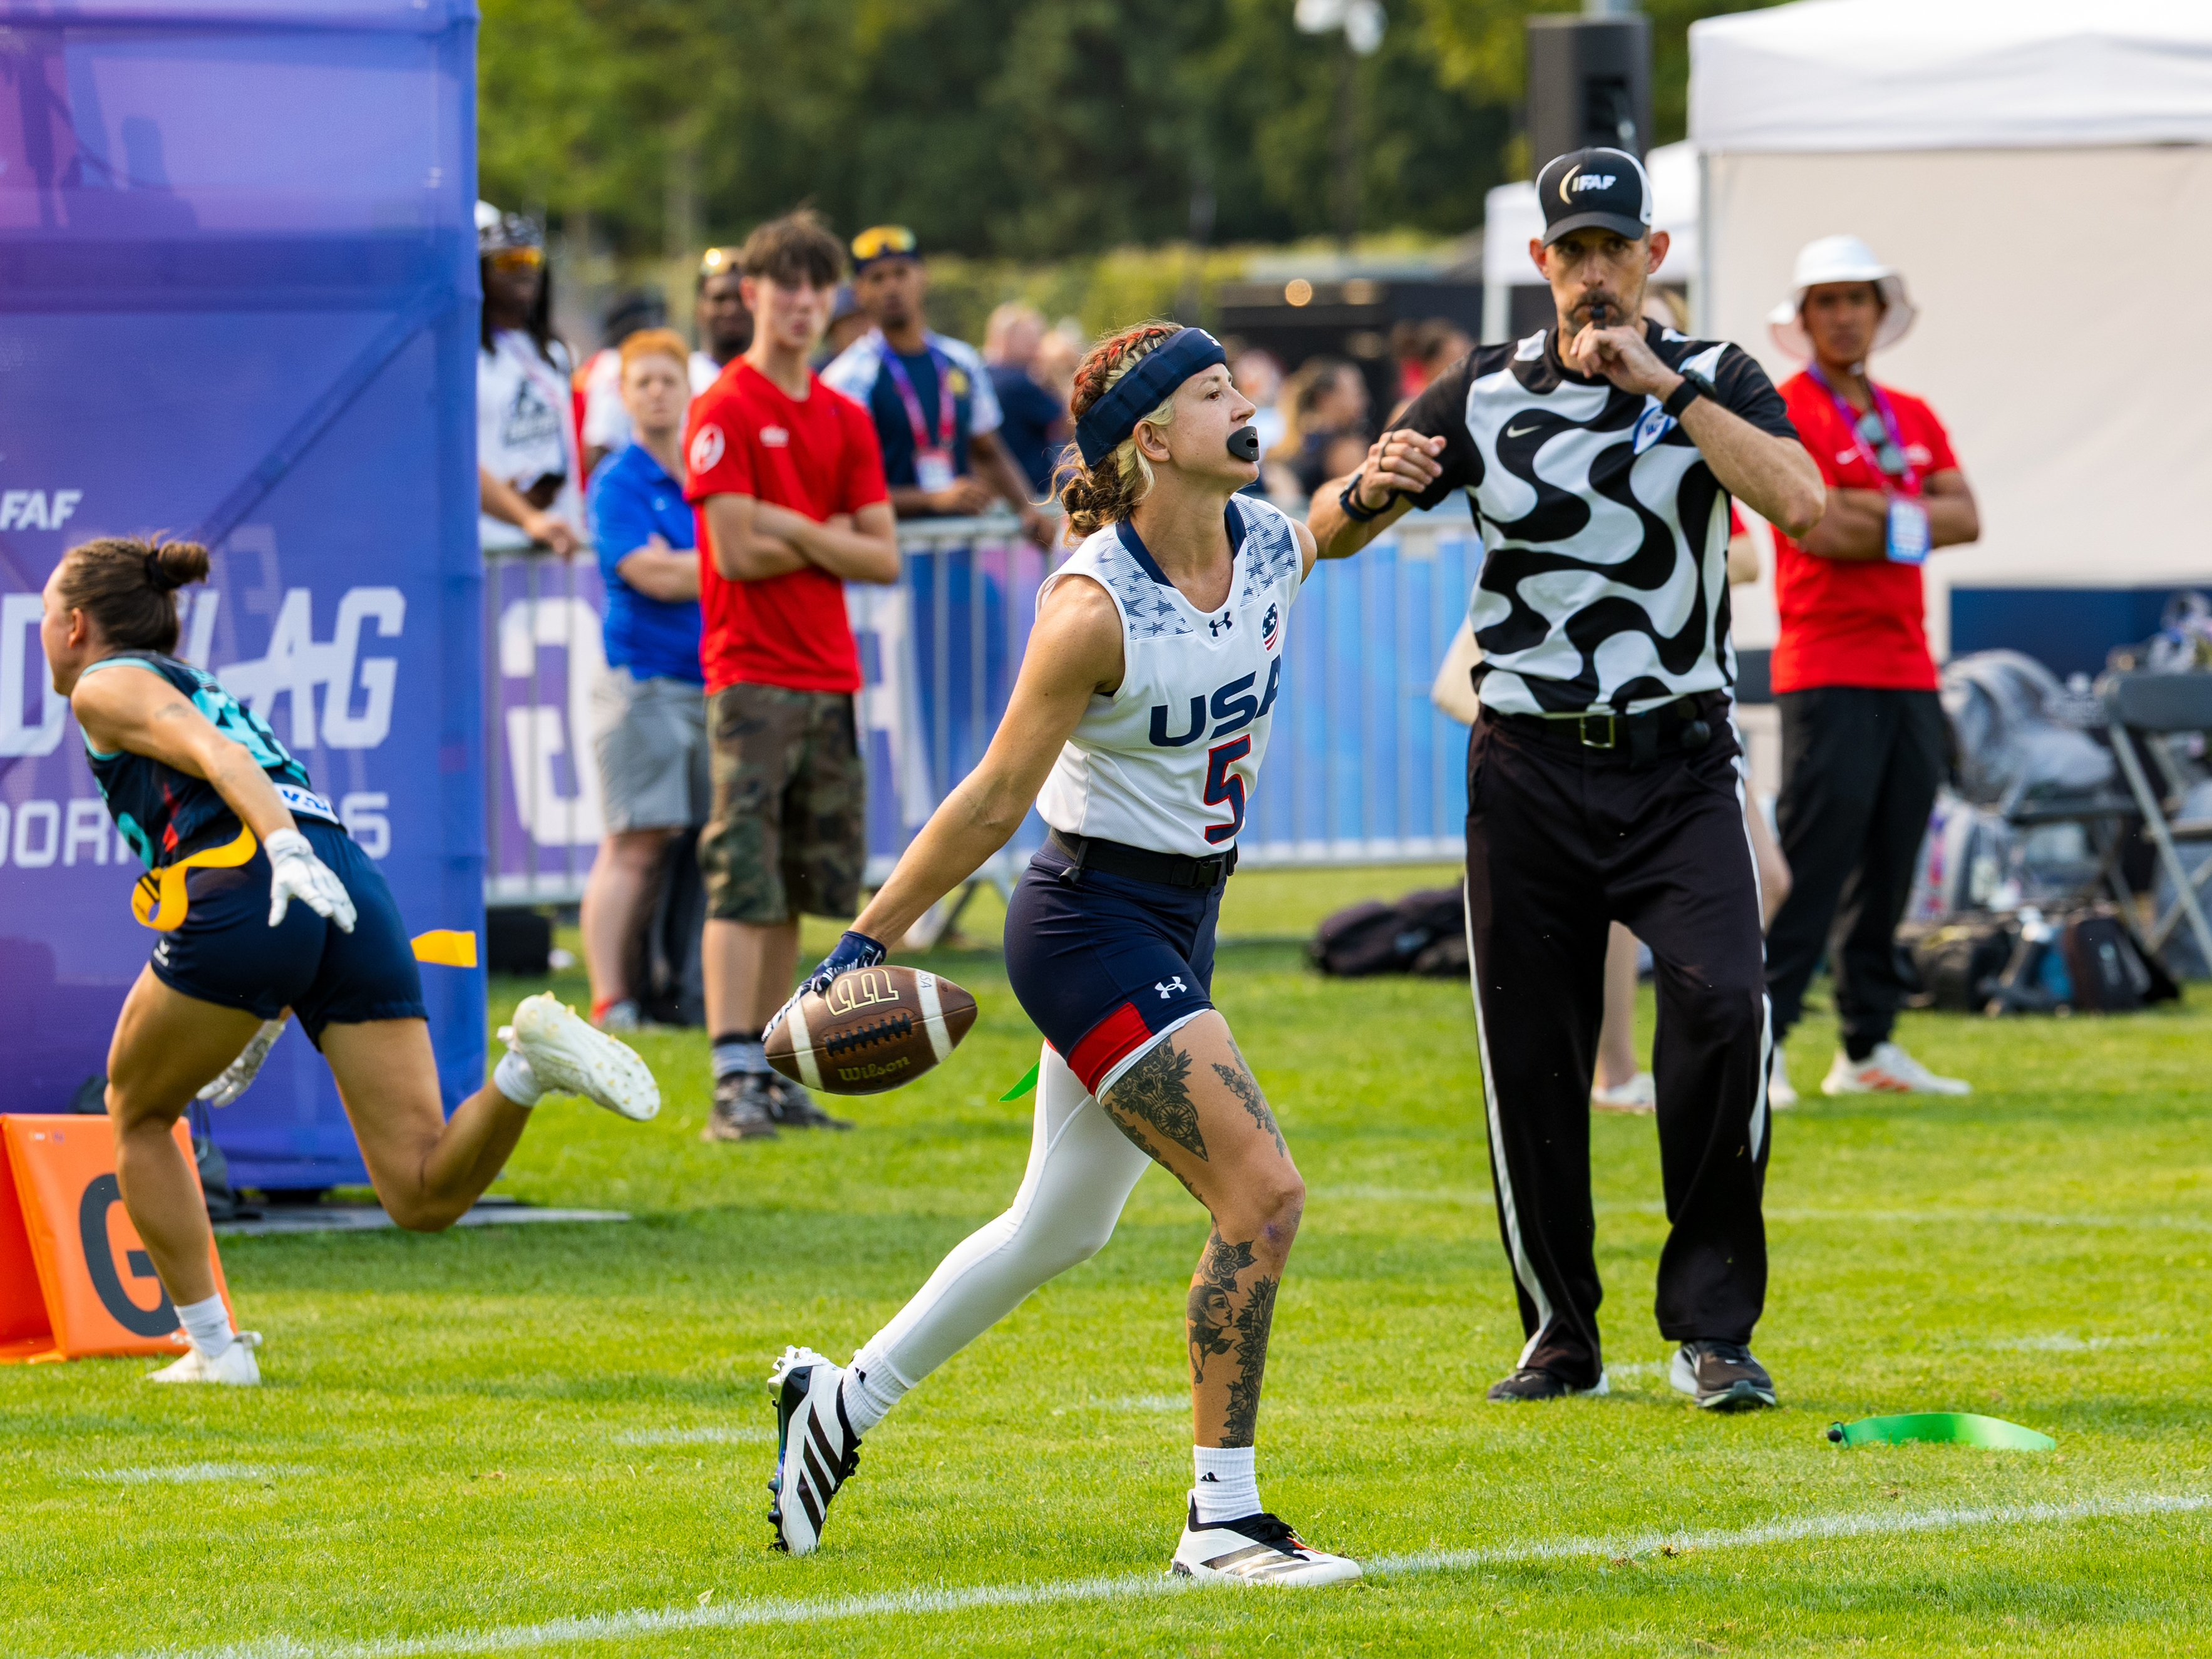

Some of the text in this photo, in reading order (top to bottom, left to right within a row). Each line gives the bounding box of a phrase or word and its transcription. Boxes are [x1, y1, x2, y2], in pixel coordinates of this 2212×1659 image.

[1572, 174, 1617, 192] IFAF
[1149, 654, 1282, 747] USA
[1203, 733, 1252, 845] 5
[918, 970, 932, 989] USA
[837, 1056, 911, 1081] Wilson
[79, 1173, 183, 1337] G
